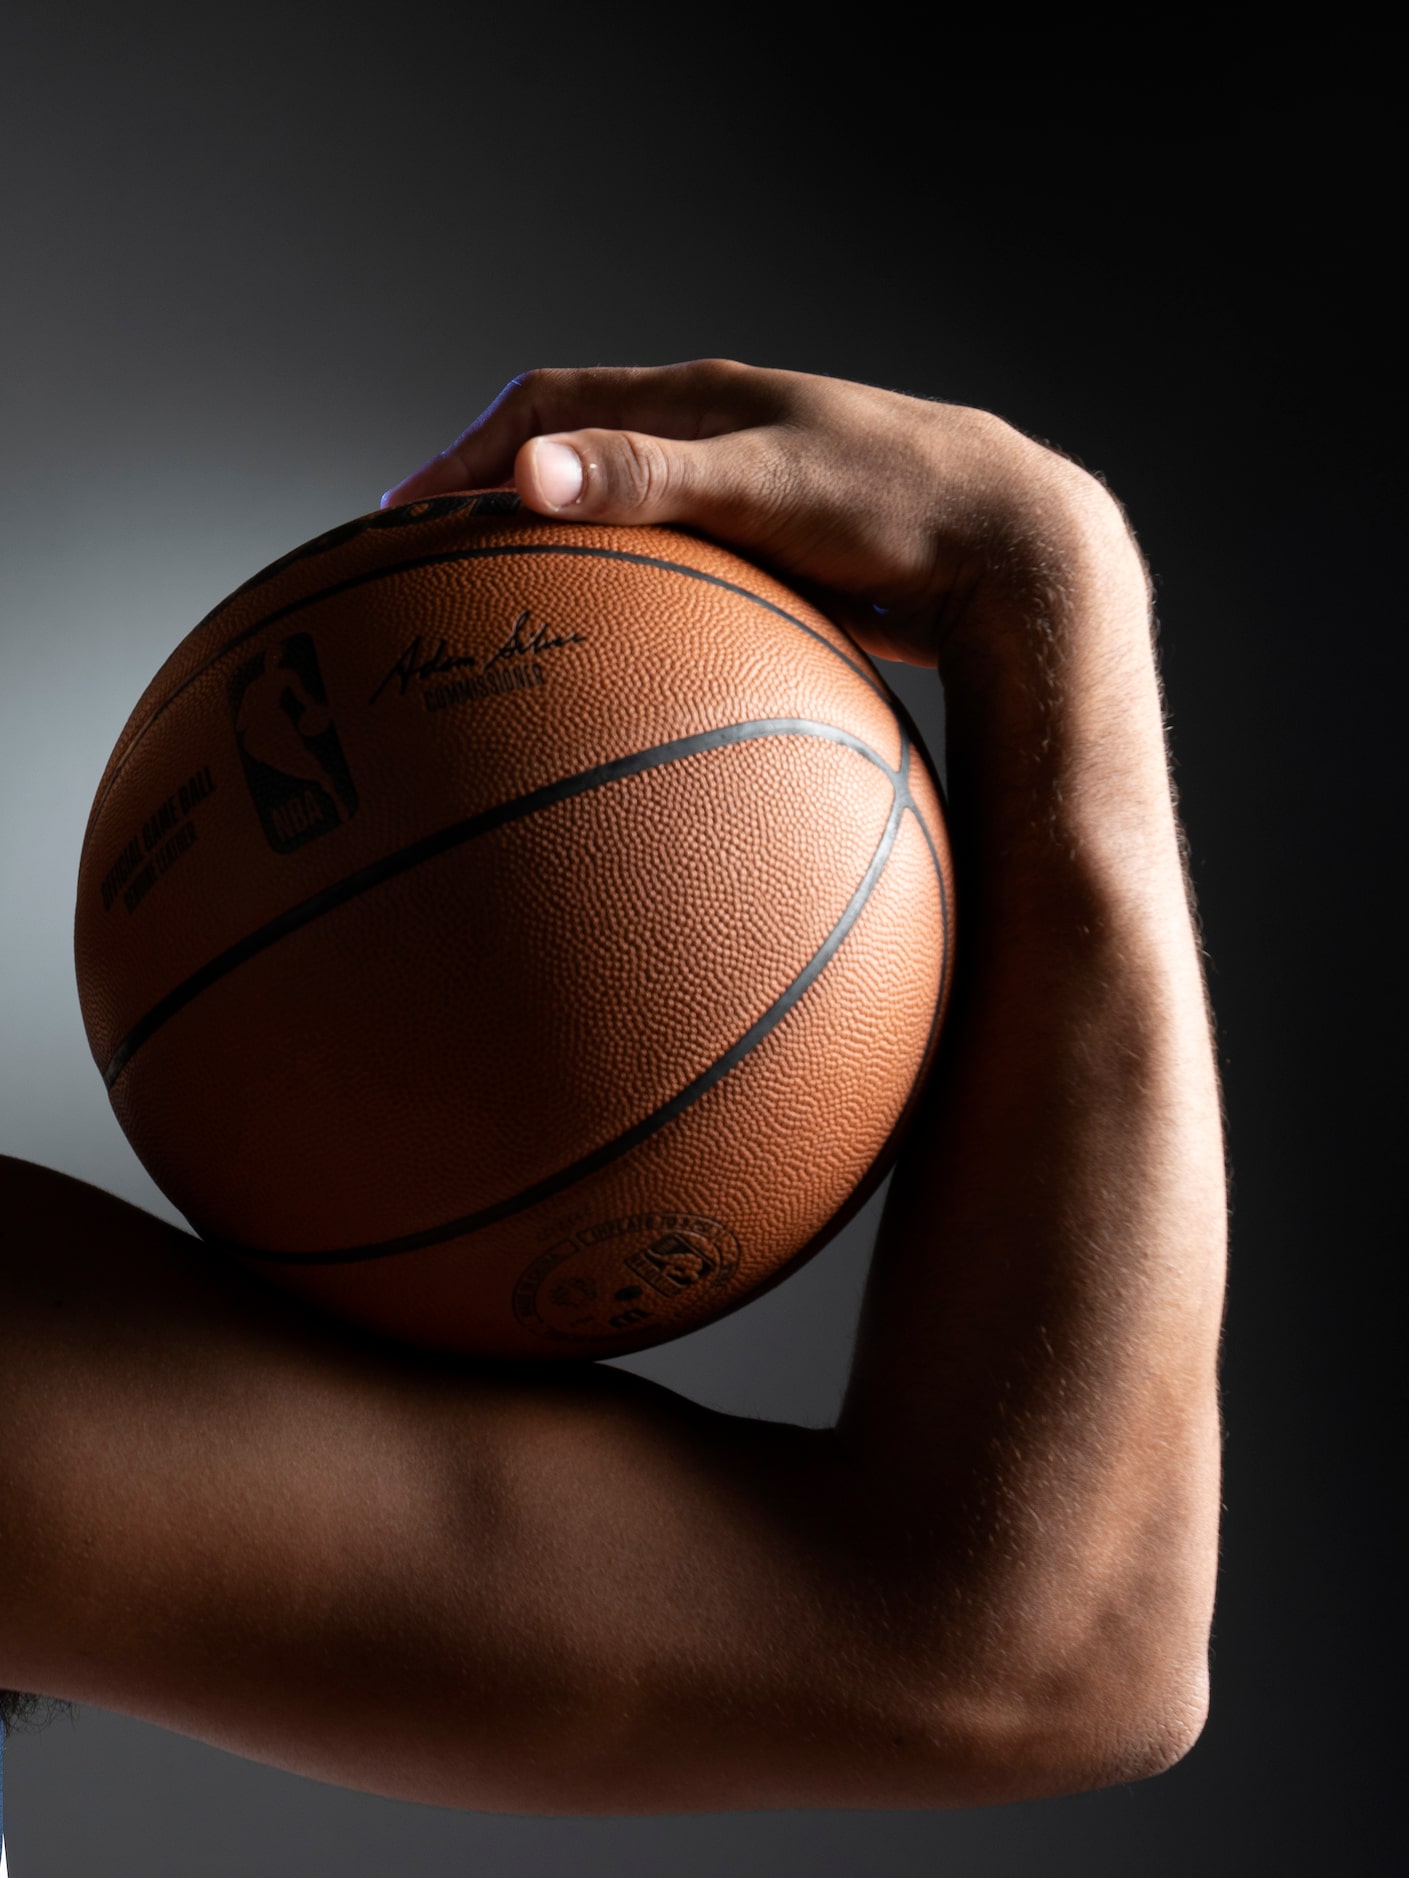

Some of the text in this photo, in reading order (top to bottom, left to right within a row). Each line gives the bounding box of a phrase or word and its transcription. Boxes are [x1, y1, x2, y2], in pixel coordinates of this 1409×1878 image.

[422, 664, 546, 713] COMMISSIONER
[101, 764, 217, 912] OFFICIAL GAME BALL
[271, 789, 326, 844] NBA
